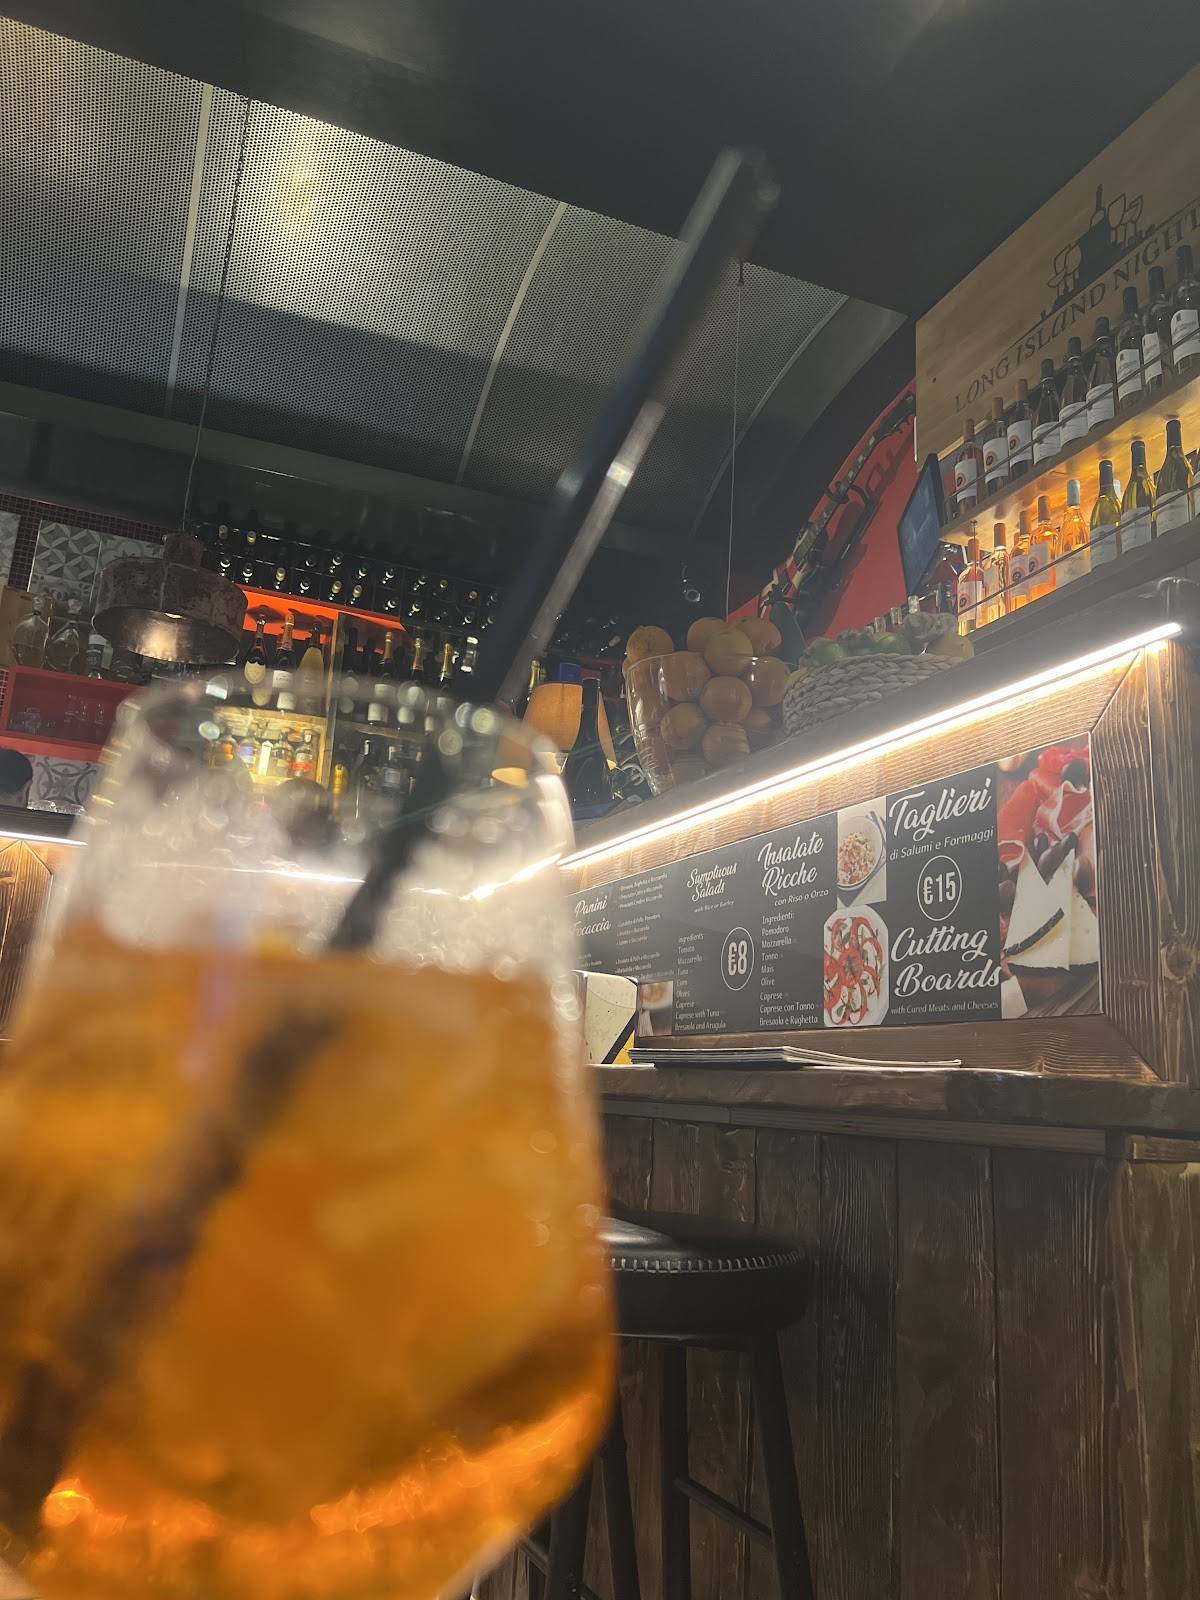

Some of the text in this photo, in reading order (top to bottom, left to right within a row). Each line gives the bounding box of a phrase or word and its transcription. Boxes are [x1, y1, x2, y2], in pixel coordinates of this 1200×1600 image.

[955, 357, 1009, 412] LONG
[1017, 282, 1105, 366] ISLAND
[889, 777, 992, 841] Taglieri
[757, 831, 824, 870] Insalate
[890, 826, 994, 860] di Salumi e Formaggi
[687, 863, 738, 888] Sumptuous
[762, 862, 818, 896] Ricche
[923, 871, 956, 905] €15
[692, 878, 726, 902] Salads
[774, 898, 787, 907] con
[788, 894, 803, 904] Riso
[810, 889, 829, 899] Orzo
[574, 895, 608, 917] Panini
[761, 937, 792, 949] Mozzarella
[762, 925, 789, 937] Pomodoro
[890, 925, 988, 962] Cutting
[727, 940, 748, 976] €8
[761, 952, 779, 961] Tonno
[894, 958, 1002, 997] Boards
[760, 992, 783, 1002] Caprese
[760, 1004, 783, 1015] Caprese
[784, 1004, 795, 1012] con
[890, 1000, 999, 1015] with Cured Meats and Cheeses
